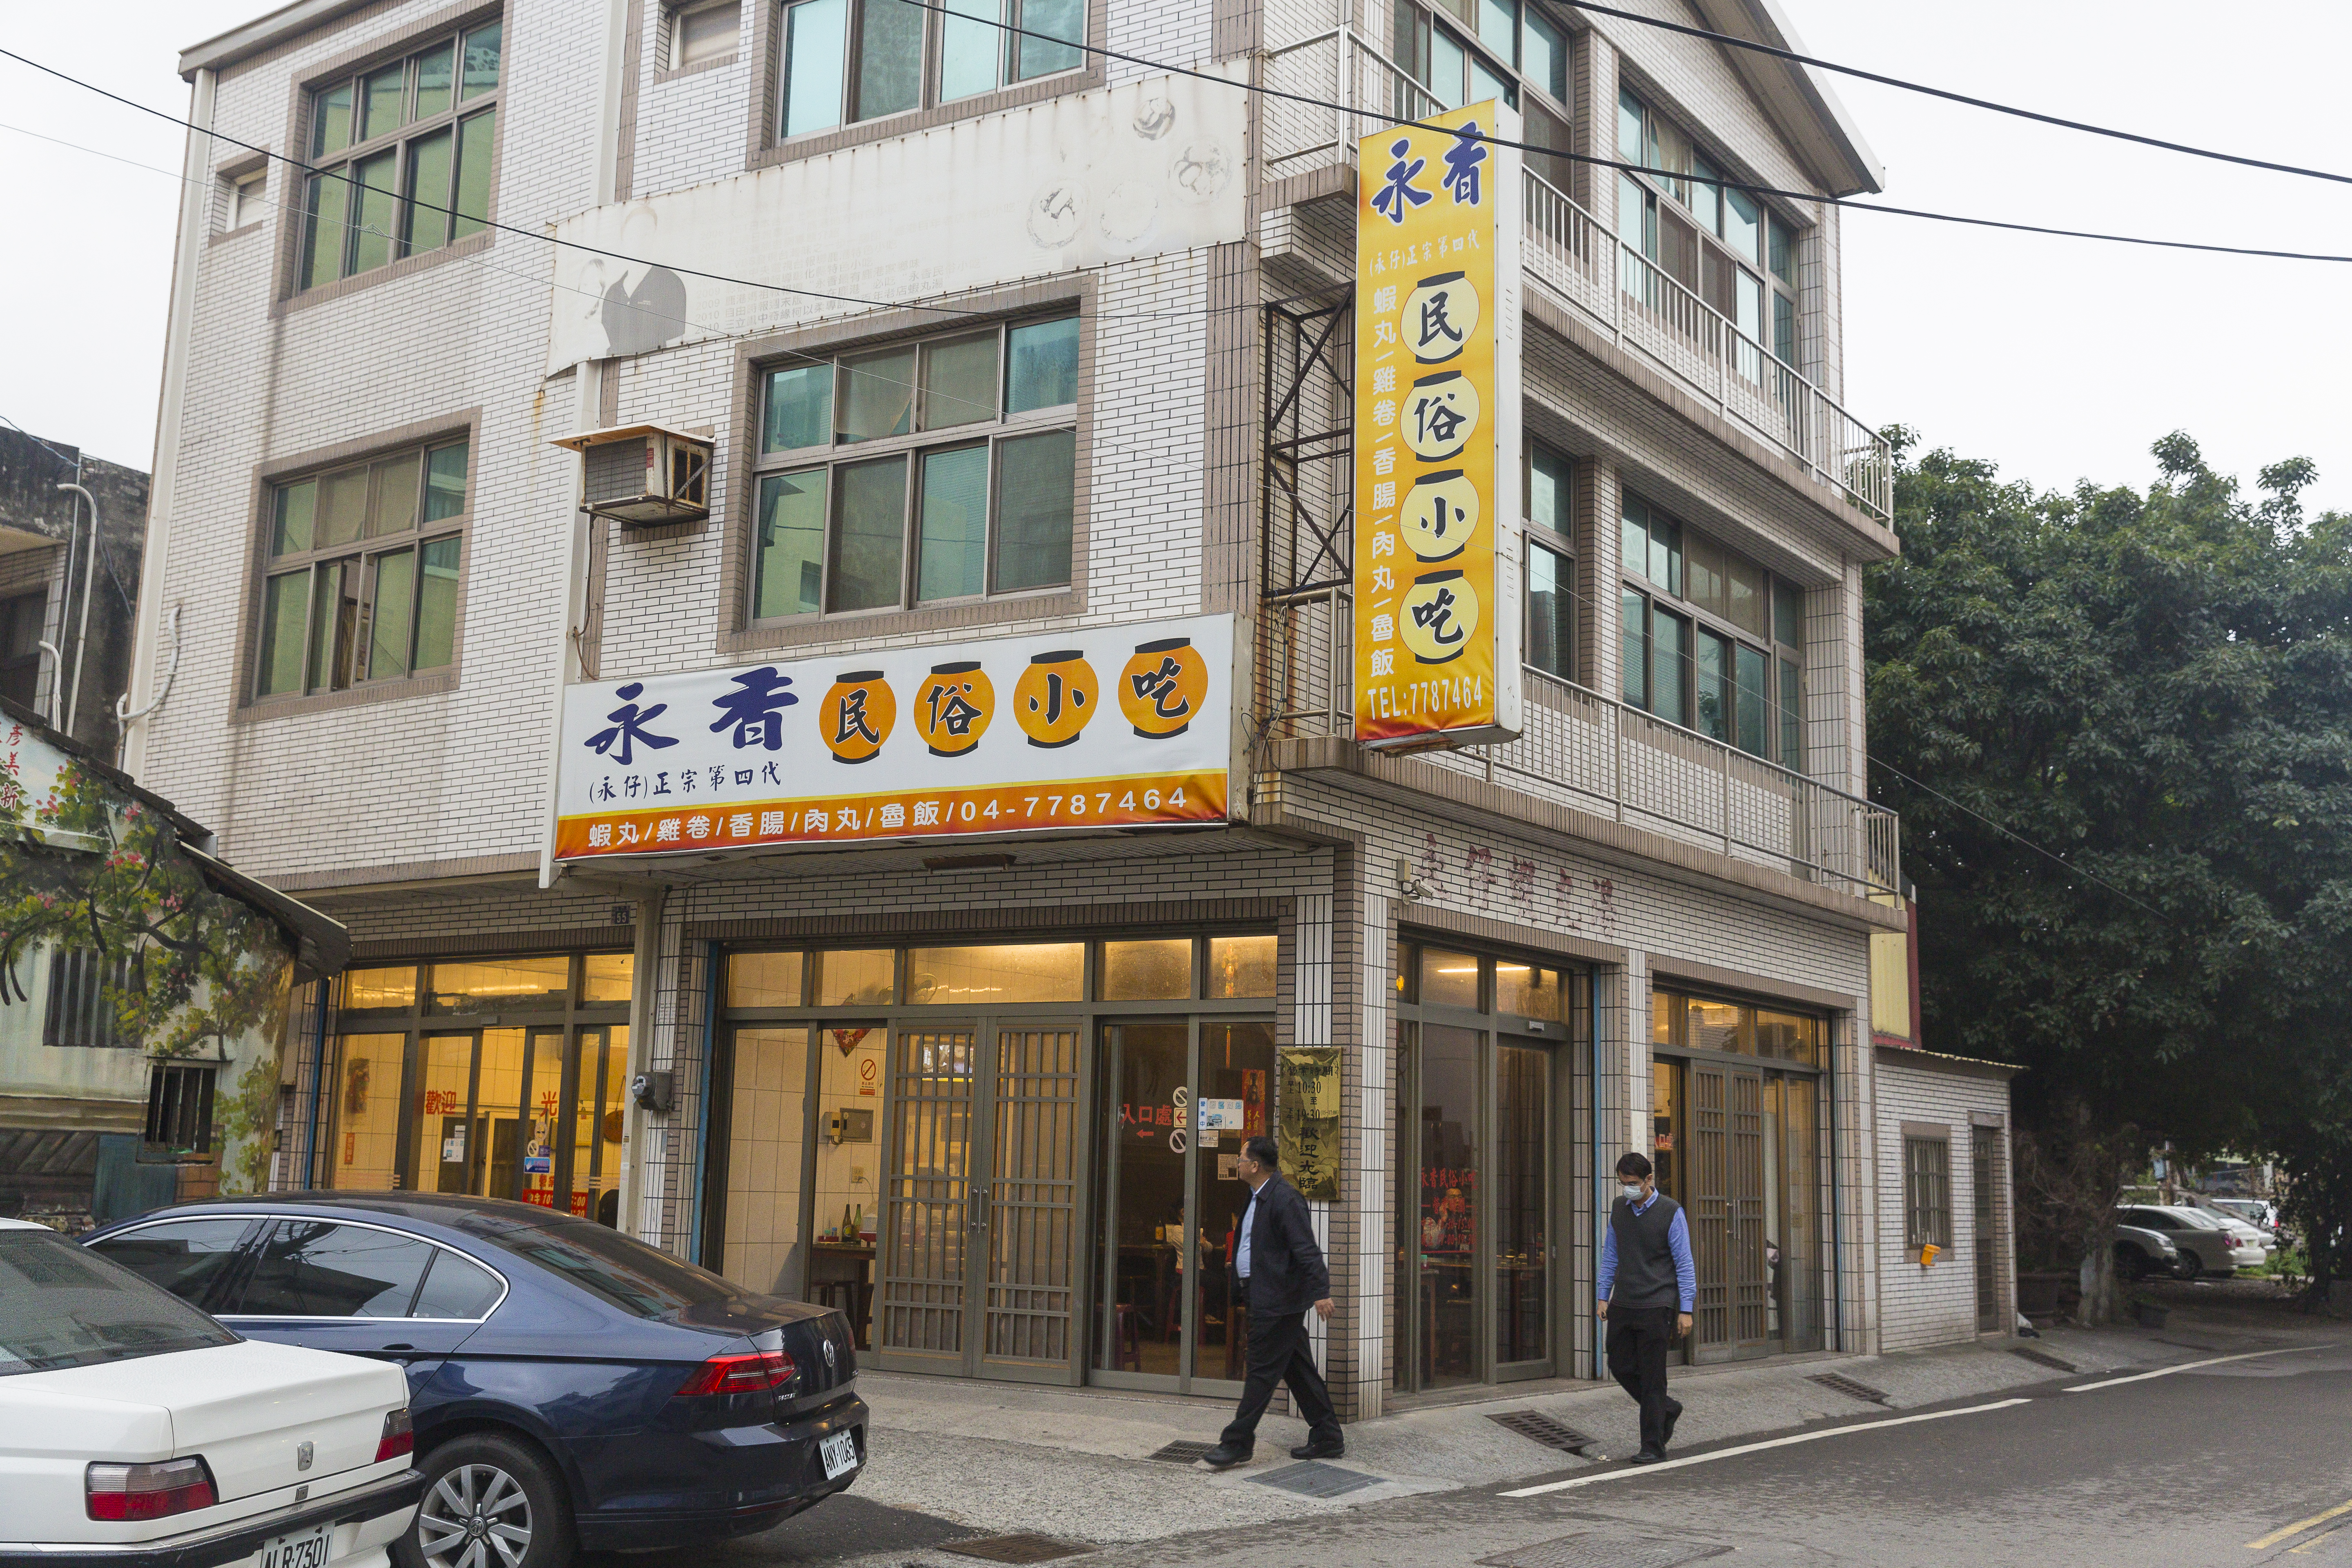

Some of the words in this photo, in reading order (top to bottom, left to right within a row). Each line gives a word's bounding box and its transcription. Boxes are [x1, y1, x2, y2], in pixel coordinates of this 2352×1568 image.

[1372, 121, 1487, 224] 永香
[695, 312, 720, 323] 2010
[1412, 291, 1467, 645] 民俗小吃
[584, 667, 800, 766] 永香
[837, 655, 1191, 746] 民俗小吃
[1298, 1081, 1321, 1094] 10:30
[425, 1090, 457, 1115] 歡迎
[540, 1091, 558, 1117] 光
[1310, 1097, 1317, 1105] 至
[1120, 1103, 1172, 1126] 入口處
[1297, 1109, 1320, 1121] 19:30
[1298, 1127, 1320, 1189] 歡迎光臨
